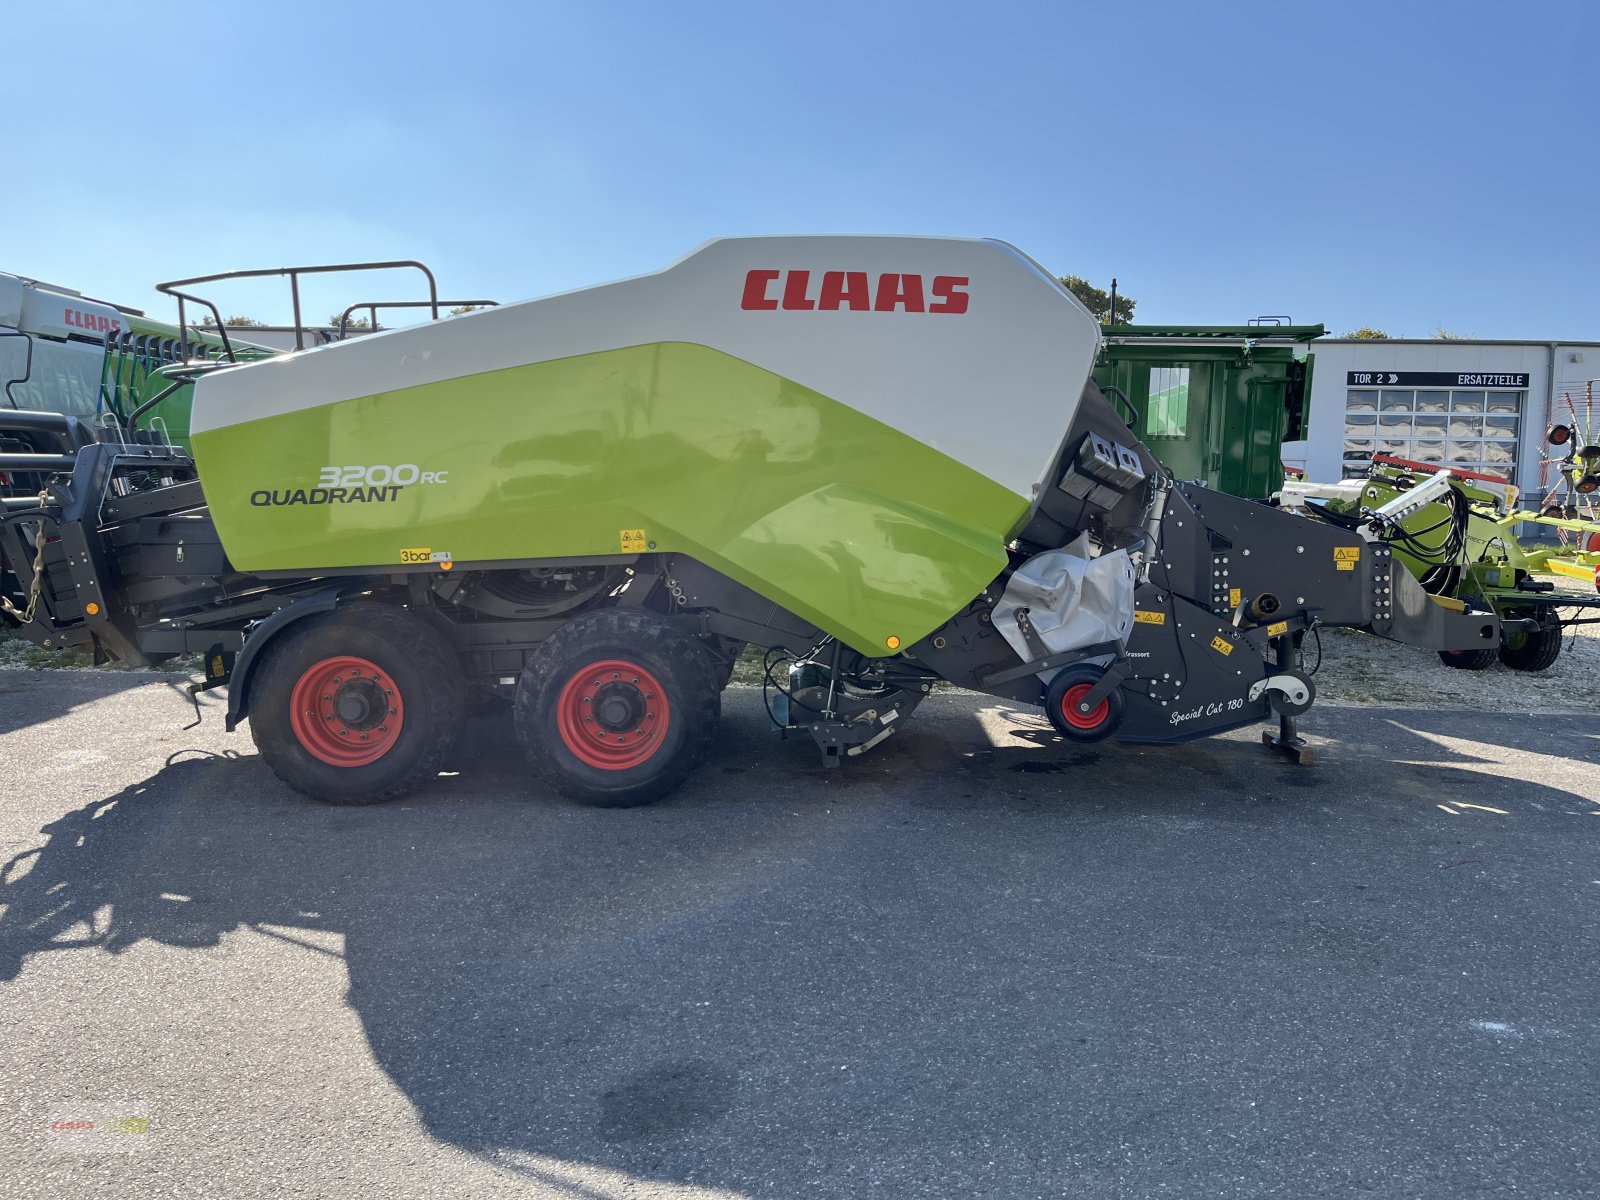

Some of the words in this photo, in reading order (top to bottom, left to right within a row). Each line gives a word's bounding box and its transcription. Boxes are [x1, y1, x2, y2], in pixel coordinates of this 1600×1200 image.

[741, 269, 969, 315] CLAAS
[64, 308, 121, 333] CLAAS
[1354, 373, 1371, 384] TOR
[1376, 373, 1384, 384] 2
[1458, 374, 1523, 386] ERSATZTEILE
[318, 464, 419, 488] 3200
[250, 486, 403, 507] QUADRANT
[401, 551, 409, 562] 3
[410, 551, 431, 561] bar
[1169, 705, 1204, 726] Special
[1227, 698, 1243, 711] 180
